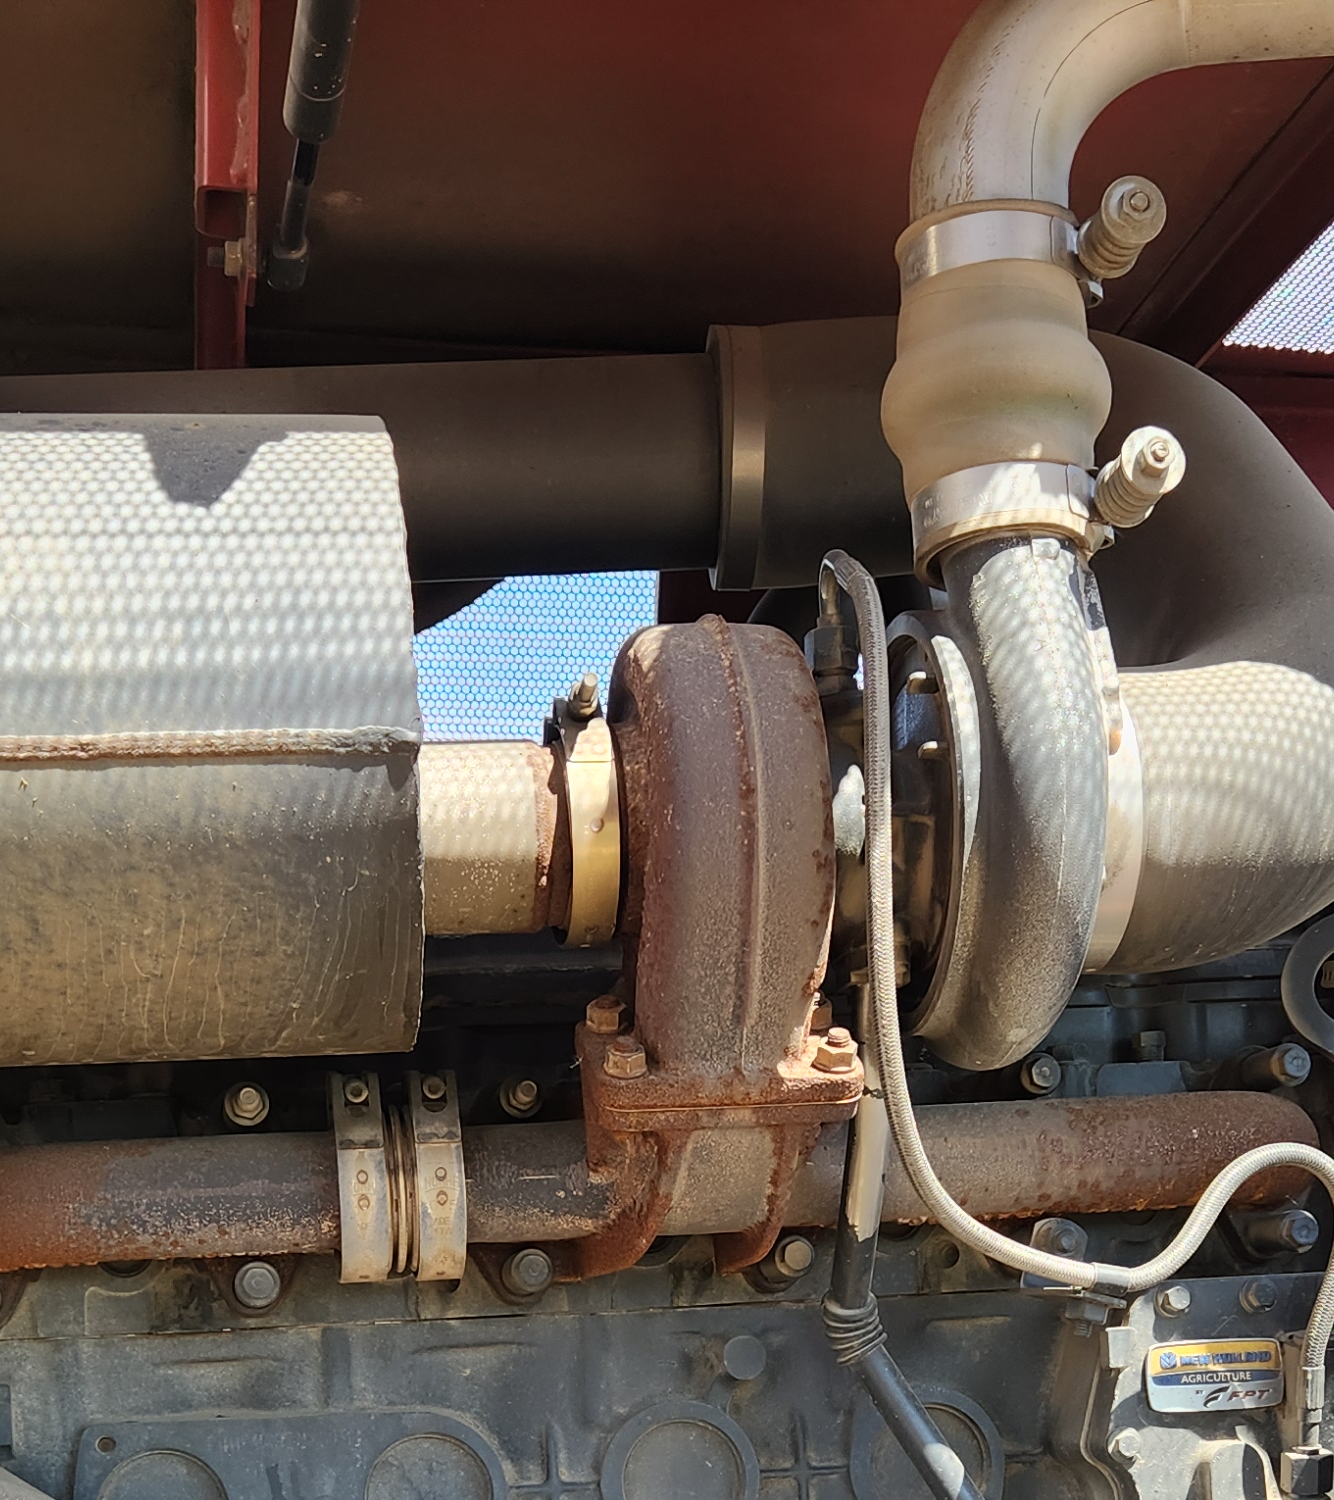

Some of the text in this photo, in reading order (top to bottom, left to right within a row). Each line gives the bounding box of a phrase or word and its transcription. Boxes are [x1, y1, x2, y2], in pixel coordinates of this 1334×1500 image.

[1179, 1350, 1272, 1367] NEW HOLLAND
[1180, 1371, 1252, 1384] AGRICULTURE
[1227, 1388, 1270, 1402] FPT
